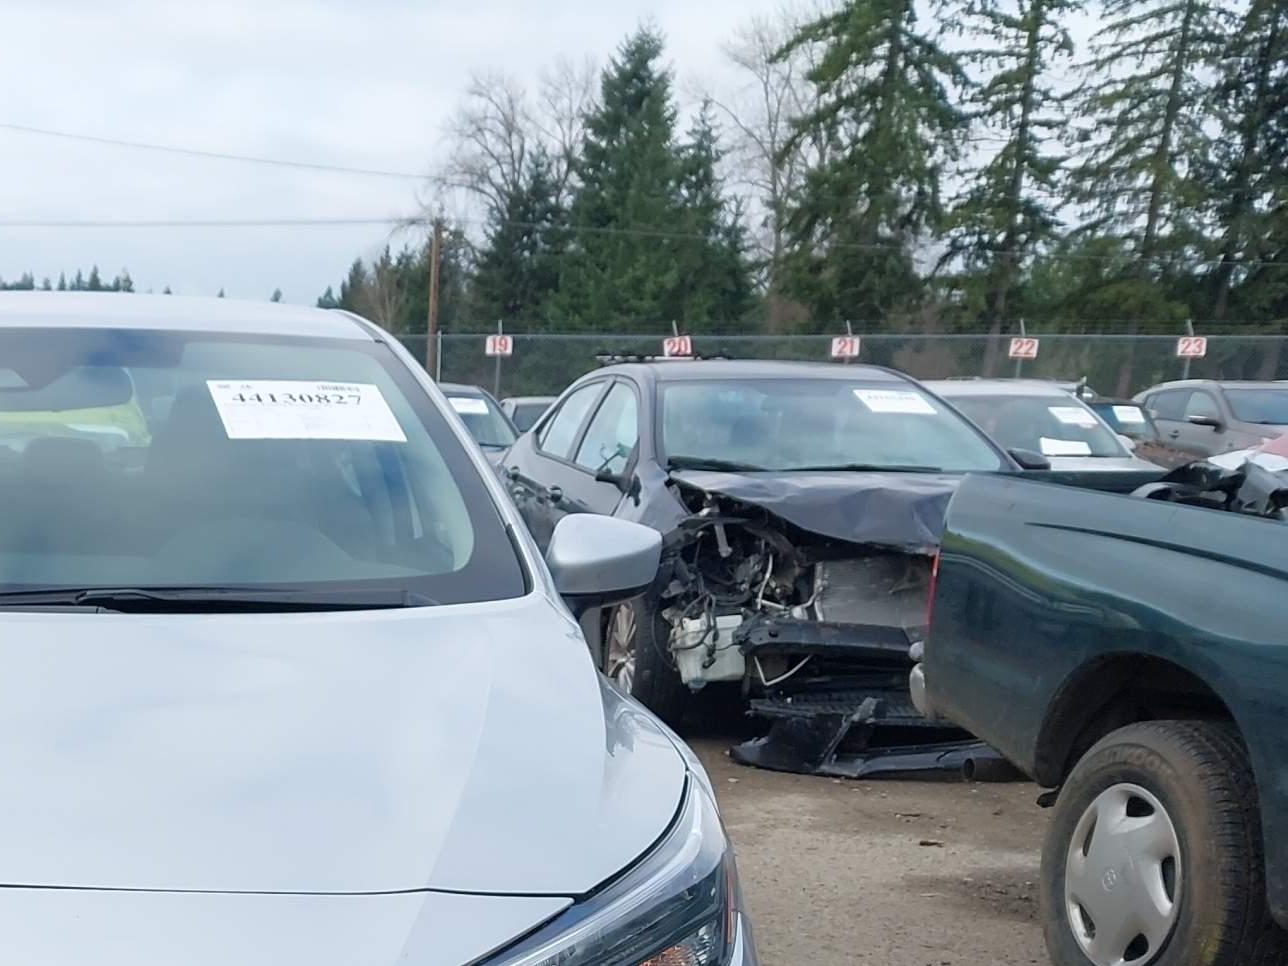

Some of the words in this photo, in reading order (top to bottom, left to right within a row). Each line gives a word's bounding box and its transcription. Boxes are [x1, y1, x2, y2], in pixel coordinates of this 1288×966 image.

[491, 336, 508, 352] 19
[667, 337, 689, 355] 20
[838, 337, 857, 353] 21
[1014, 339, 1035, 355] 22
[1181, 339, 1202, 354] 23
[232, 392, 362, 406] 44130827
